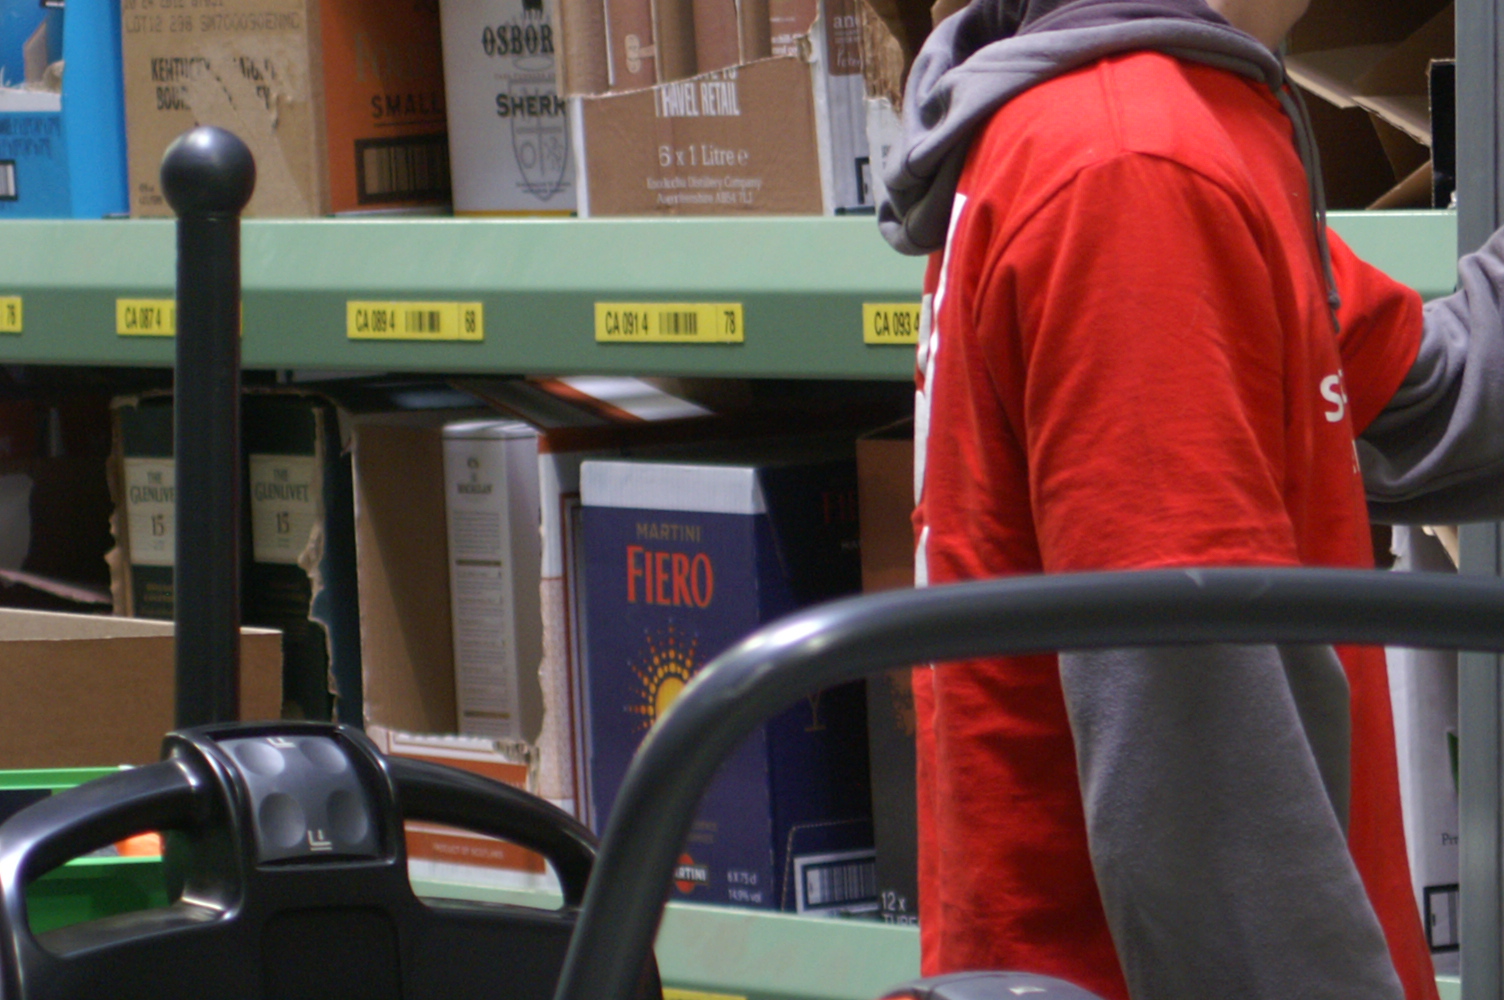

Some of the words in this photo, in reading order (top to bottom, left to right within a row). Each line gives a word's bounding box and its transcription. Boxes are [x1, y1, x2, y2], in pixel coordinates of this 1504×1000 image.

[701, 80, 741, 116] RETAIL
[659, 145, 672, 167] 6
[676, 149, 686, 166] x
[689, 144, 697, 166] 1
[701, 144, 736, 166] Litre
[125, 307, 140, 330] CA
[355, 308, 371, 333] CA
[389, 308, 396, 333] 4
[605, 311, 620, 336] CA
[622, 311, 639, 336] 091
[642, 311, 649, 335] 4
[723, 310, 736, 335] 78
[874, 311, 890, 336] CA
[892, 311, 911, 336] 093
[636, 522, 701, 542] MARTINI
[626, 545, 714, 608] FIERO
[882, 892, 895, 912] 12
